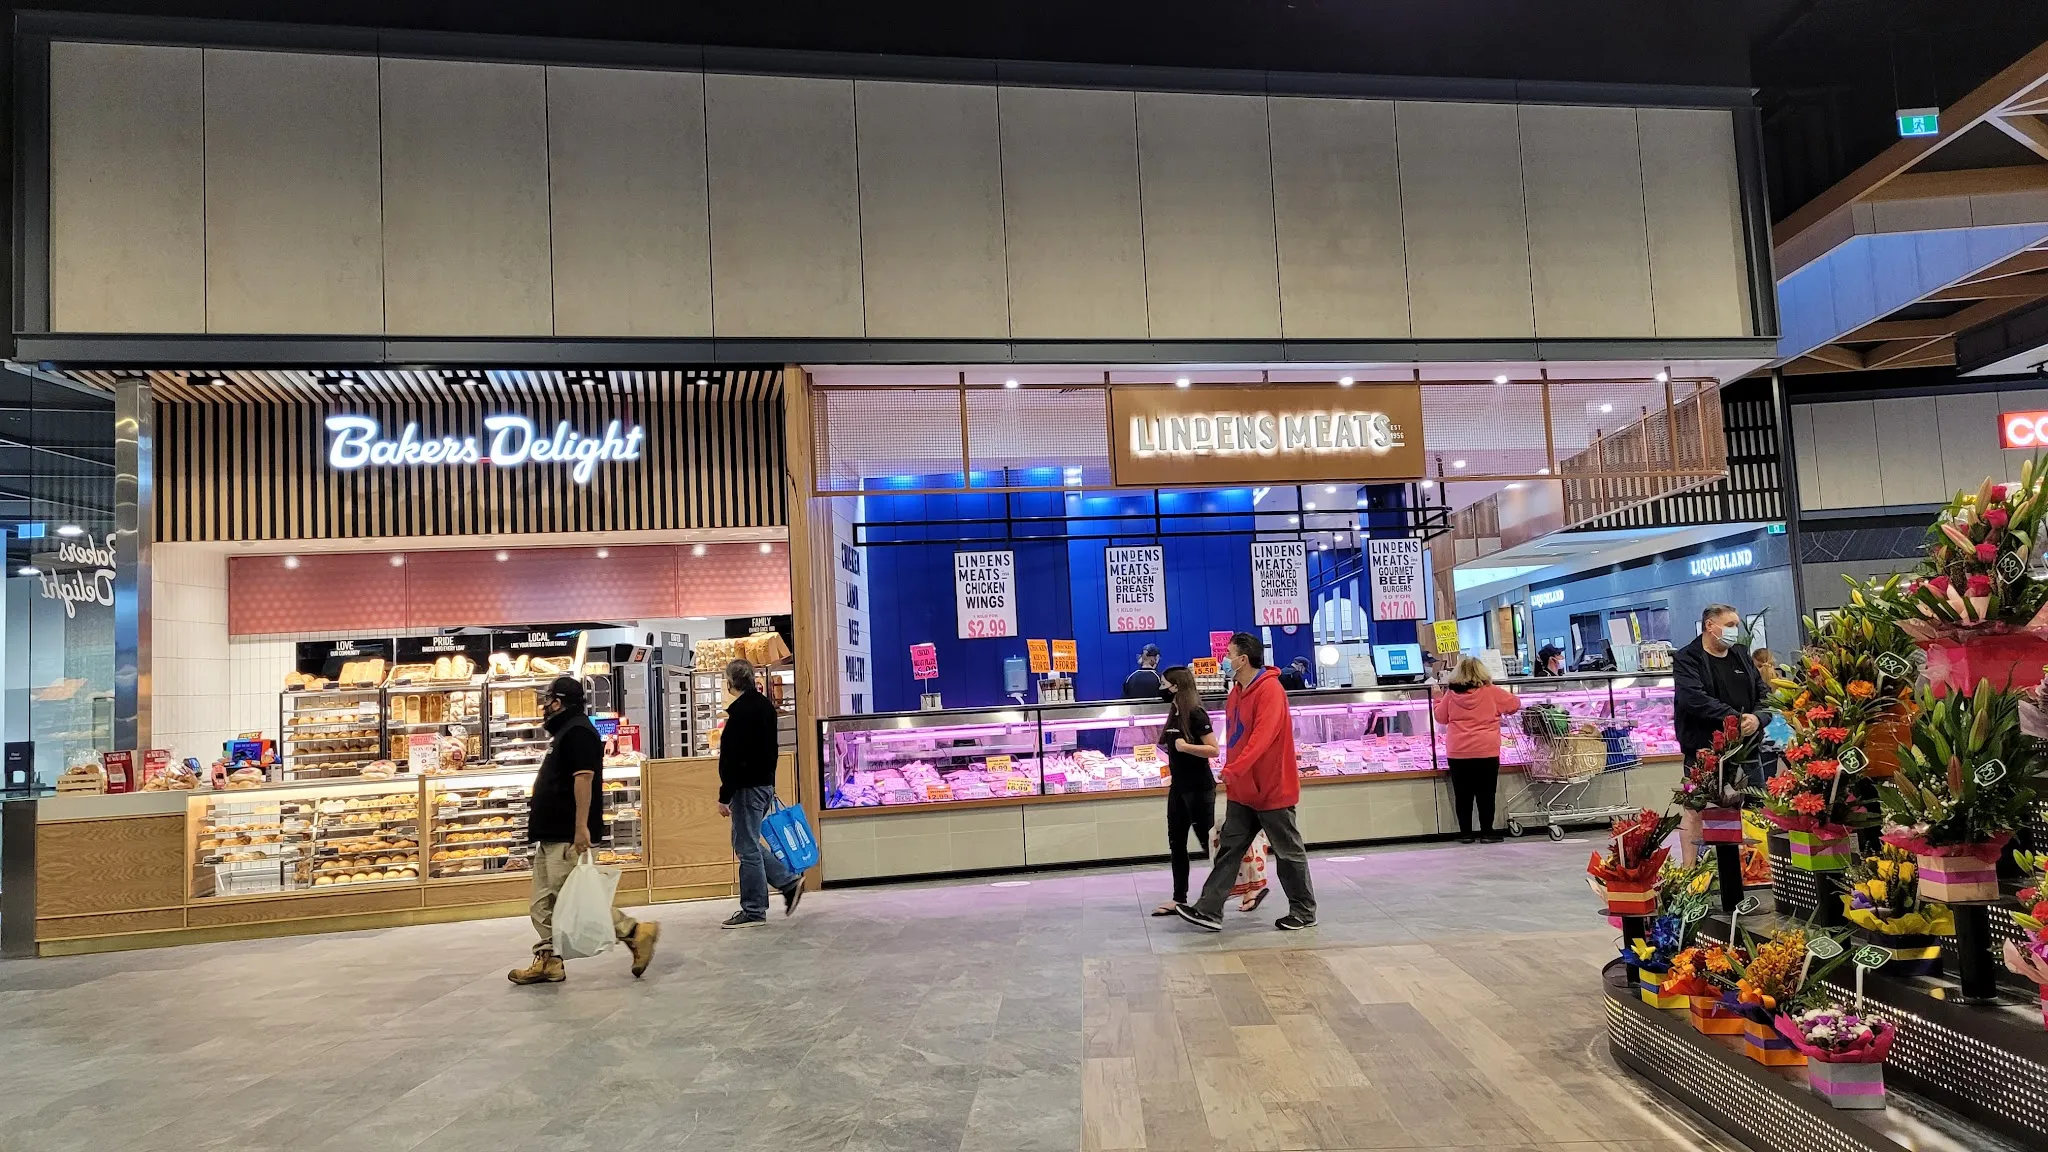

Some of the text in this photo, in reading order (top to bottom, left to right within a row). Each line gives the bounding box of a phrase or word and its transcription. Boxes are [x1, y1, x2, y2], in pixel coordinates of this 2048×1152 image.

[1137, 414, 1392, 450] LINDENS MEATS
[325, 416, 643, 484] Bakers Delight
[1254, 545, 1302, 558] LINDENS
[1371, 541, 1418, 554] LINDENS
[958, 554, 1011, 568] LINDENS
[1109, 549, 1160, 563] LINDENS
[1372, 554, 1409, 567] MEATS
[1110, 563, 1150, 576] MEATS
[1255, 558, 1293, 571] MEATS
[1690, 549, 1752, 577] LIQUORLAND
[959, 568, 1000, 581] MEATS
[1260, 569, 1297, 579] MARINATED
[1378, 566, 1413, 576] GOURMET
[1115, 575, 1154, 585] CHICKEN
[1260, 579, 1298, 588] CHICKEN
[1379, 575, 1414, 585] BEEF
[965, 582, 1005, 595] CHICKEN
[1115, 585, 1154, 593] BREAST
[1261, 588, 1298, 598] DRUMETTES
[1382, 585, 1412, 593] BURGERS
[966, 595, 1004, 609] WINGS
[1116, 593, 1155, 604] FILLETS
[1263, 607, 1299, 625] $15.00
[1381, 601, 1416, 620] $17.00
[752, 617, 771, 627] FAMILY
[968, 619, 1007, 638] $2.99
[1117, 616, 1155, 631] $6.99
[433, 636, 454, 646] PRIDE
[528, 632, 550, 642] LOCAL
[336, 641, 354, 650] LOVE
[1438, 641, 1459, 652] $20.00
[1059, 661, 1069, 669] FOR
[1857, 946, 1884, 965] $35
